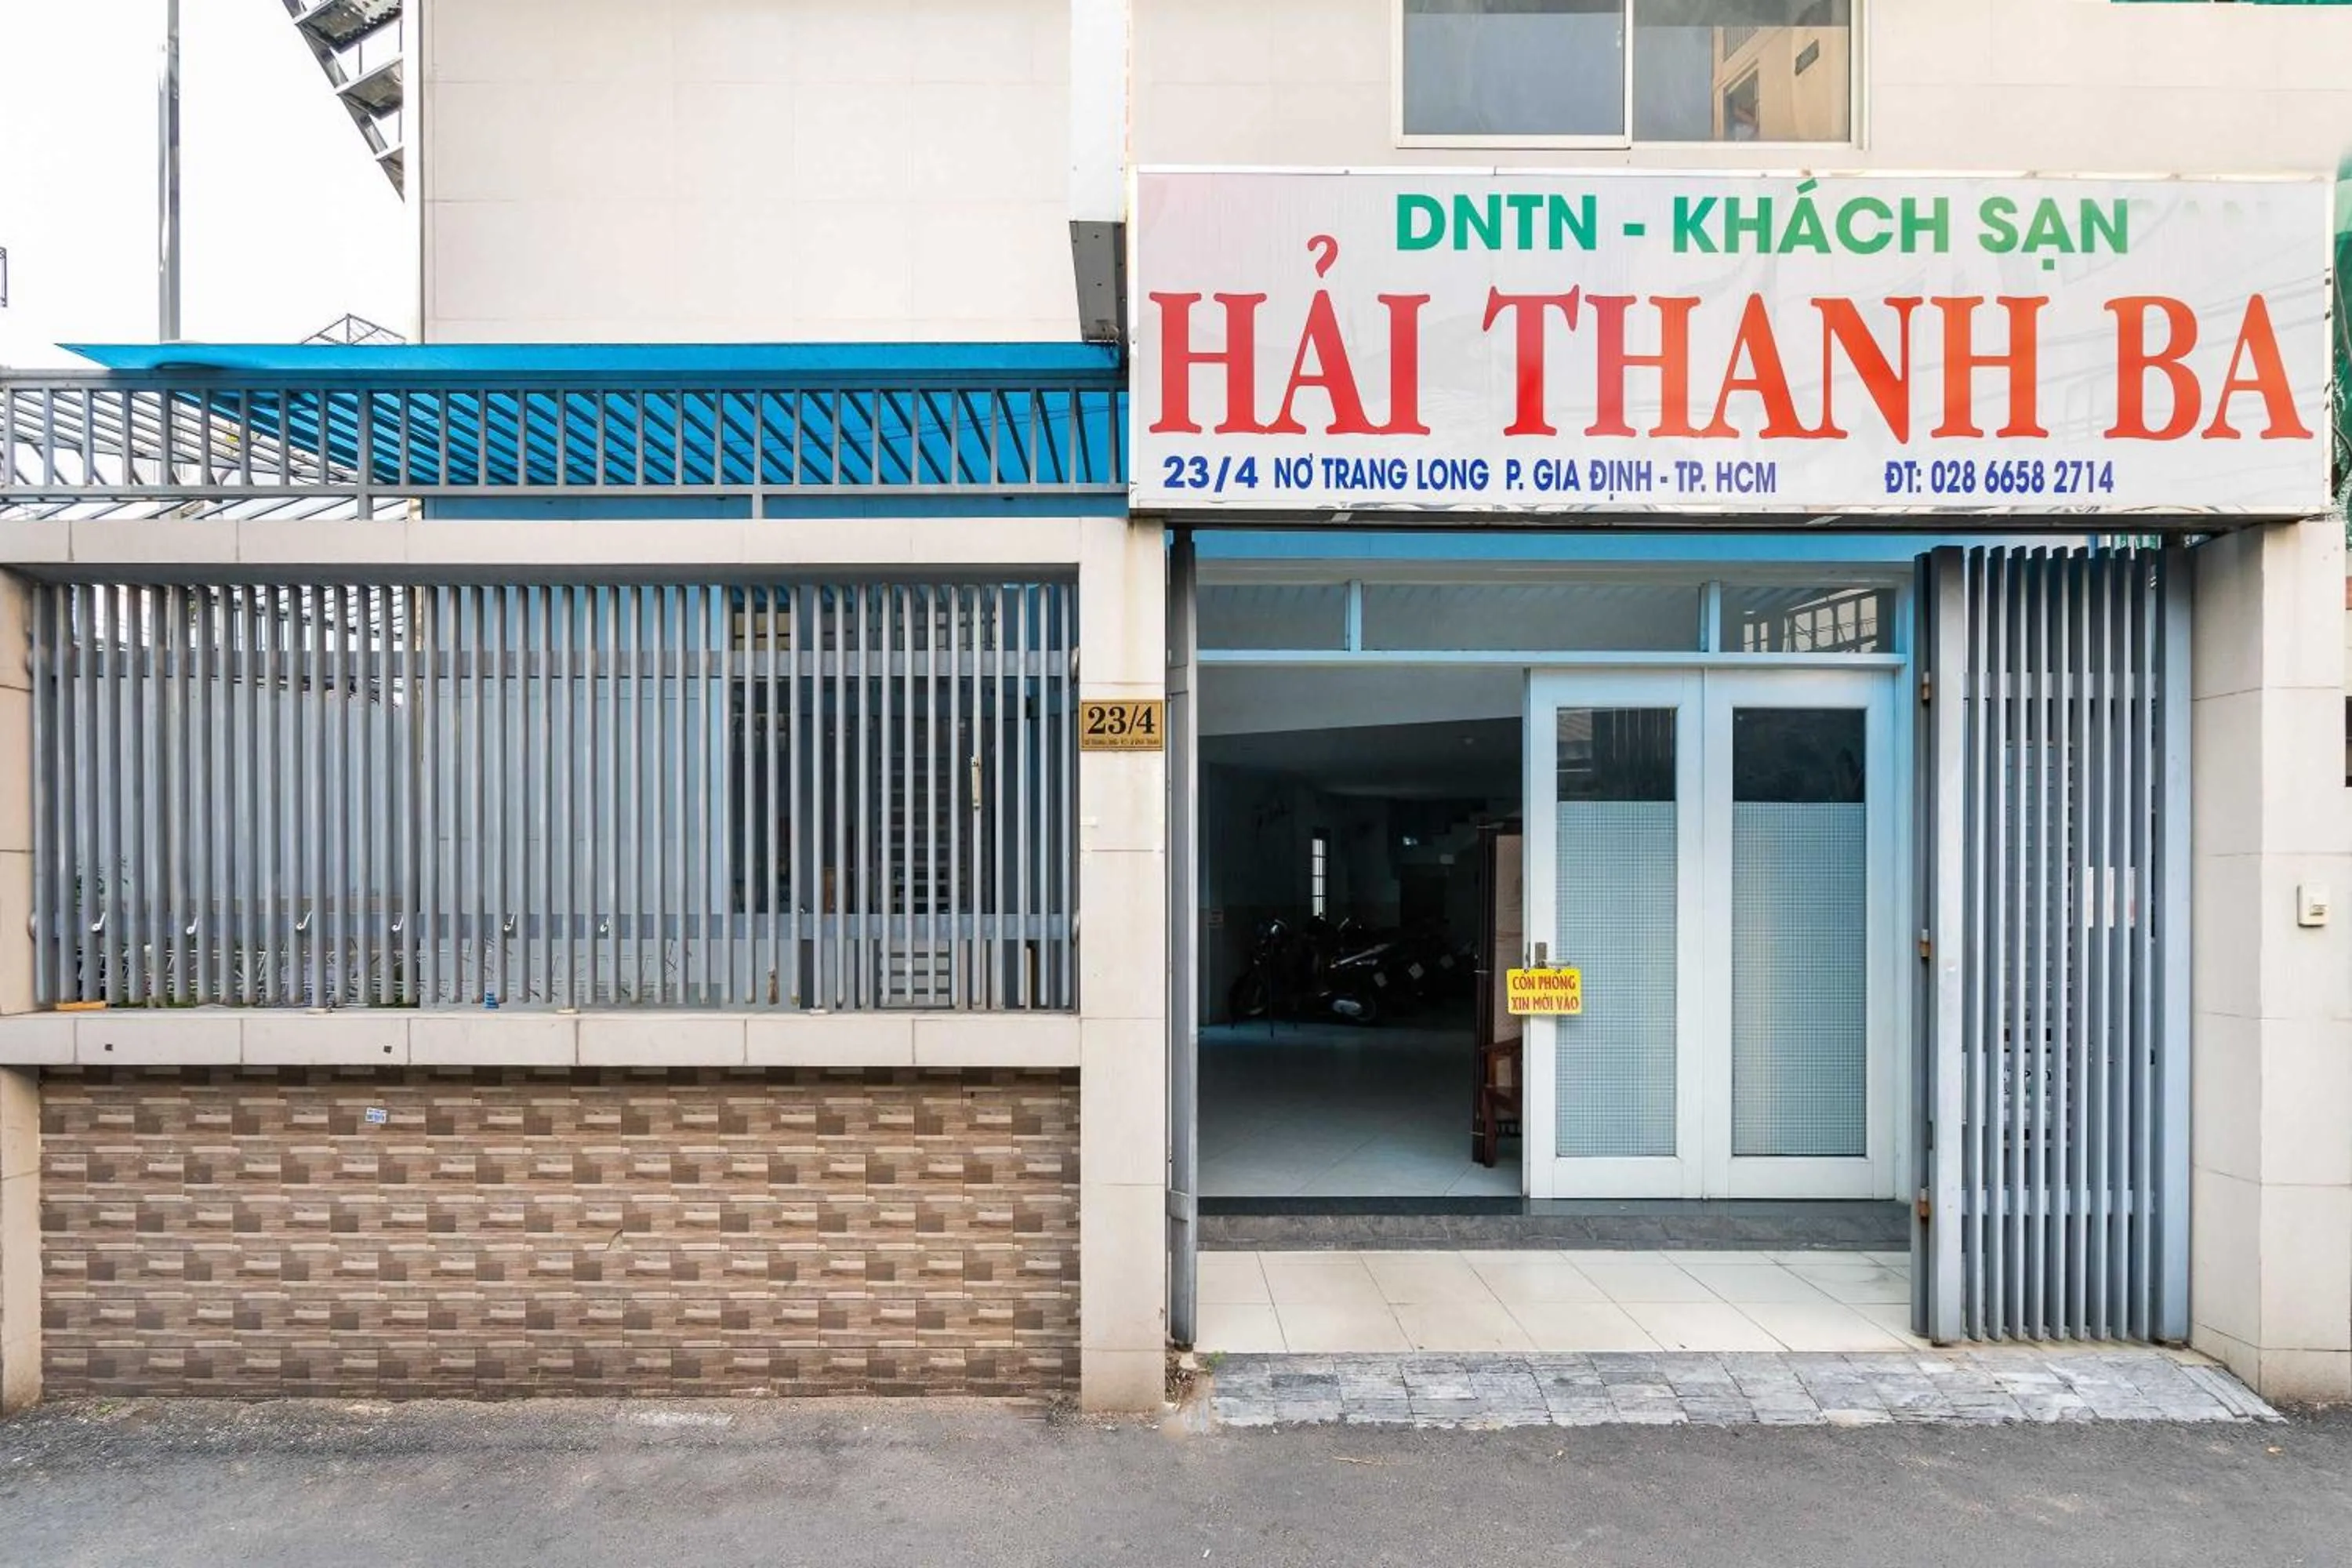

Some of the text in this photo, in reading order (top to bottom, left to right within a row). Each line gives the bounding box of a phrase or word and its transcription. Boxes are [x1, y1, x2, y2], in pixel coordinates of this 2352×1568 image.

[1395, 193, 1598, 252] DNTN
[1672, 178, 1950, 255] KHÁCH
[1978, 197, 2129, 270] SẠN
[1149, 234, 2314, 445] HẢI THANH BA
[1163, 455, 1258, 493] 23/4
[1322, 457, 1408, 491] TRANG
[1417, 458, 1490, 492] LONG
[1505, 459, 1524, 490] P.
[1533, 458, 1581, 492] GIA
[1589, 459, 1653, 500] ĐỊNH
[1675, 460, 1706, 492] TP.
[1716, 462, 1777, 493] HCM
[1884, 460, 2114, 494] ĐT: 028 6658 2714
[1087, 705, 1155, 735] 23/4
[1511, 996, 1530, 1011] XIN
